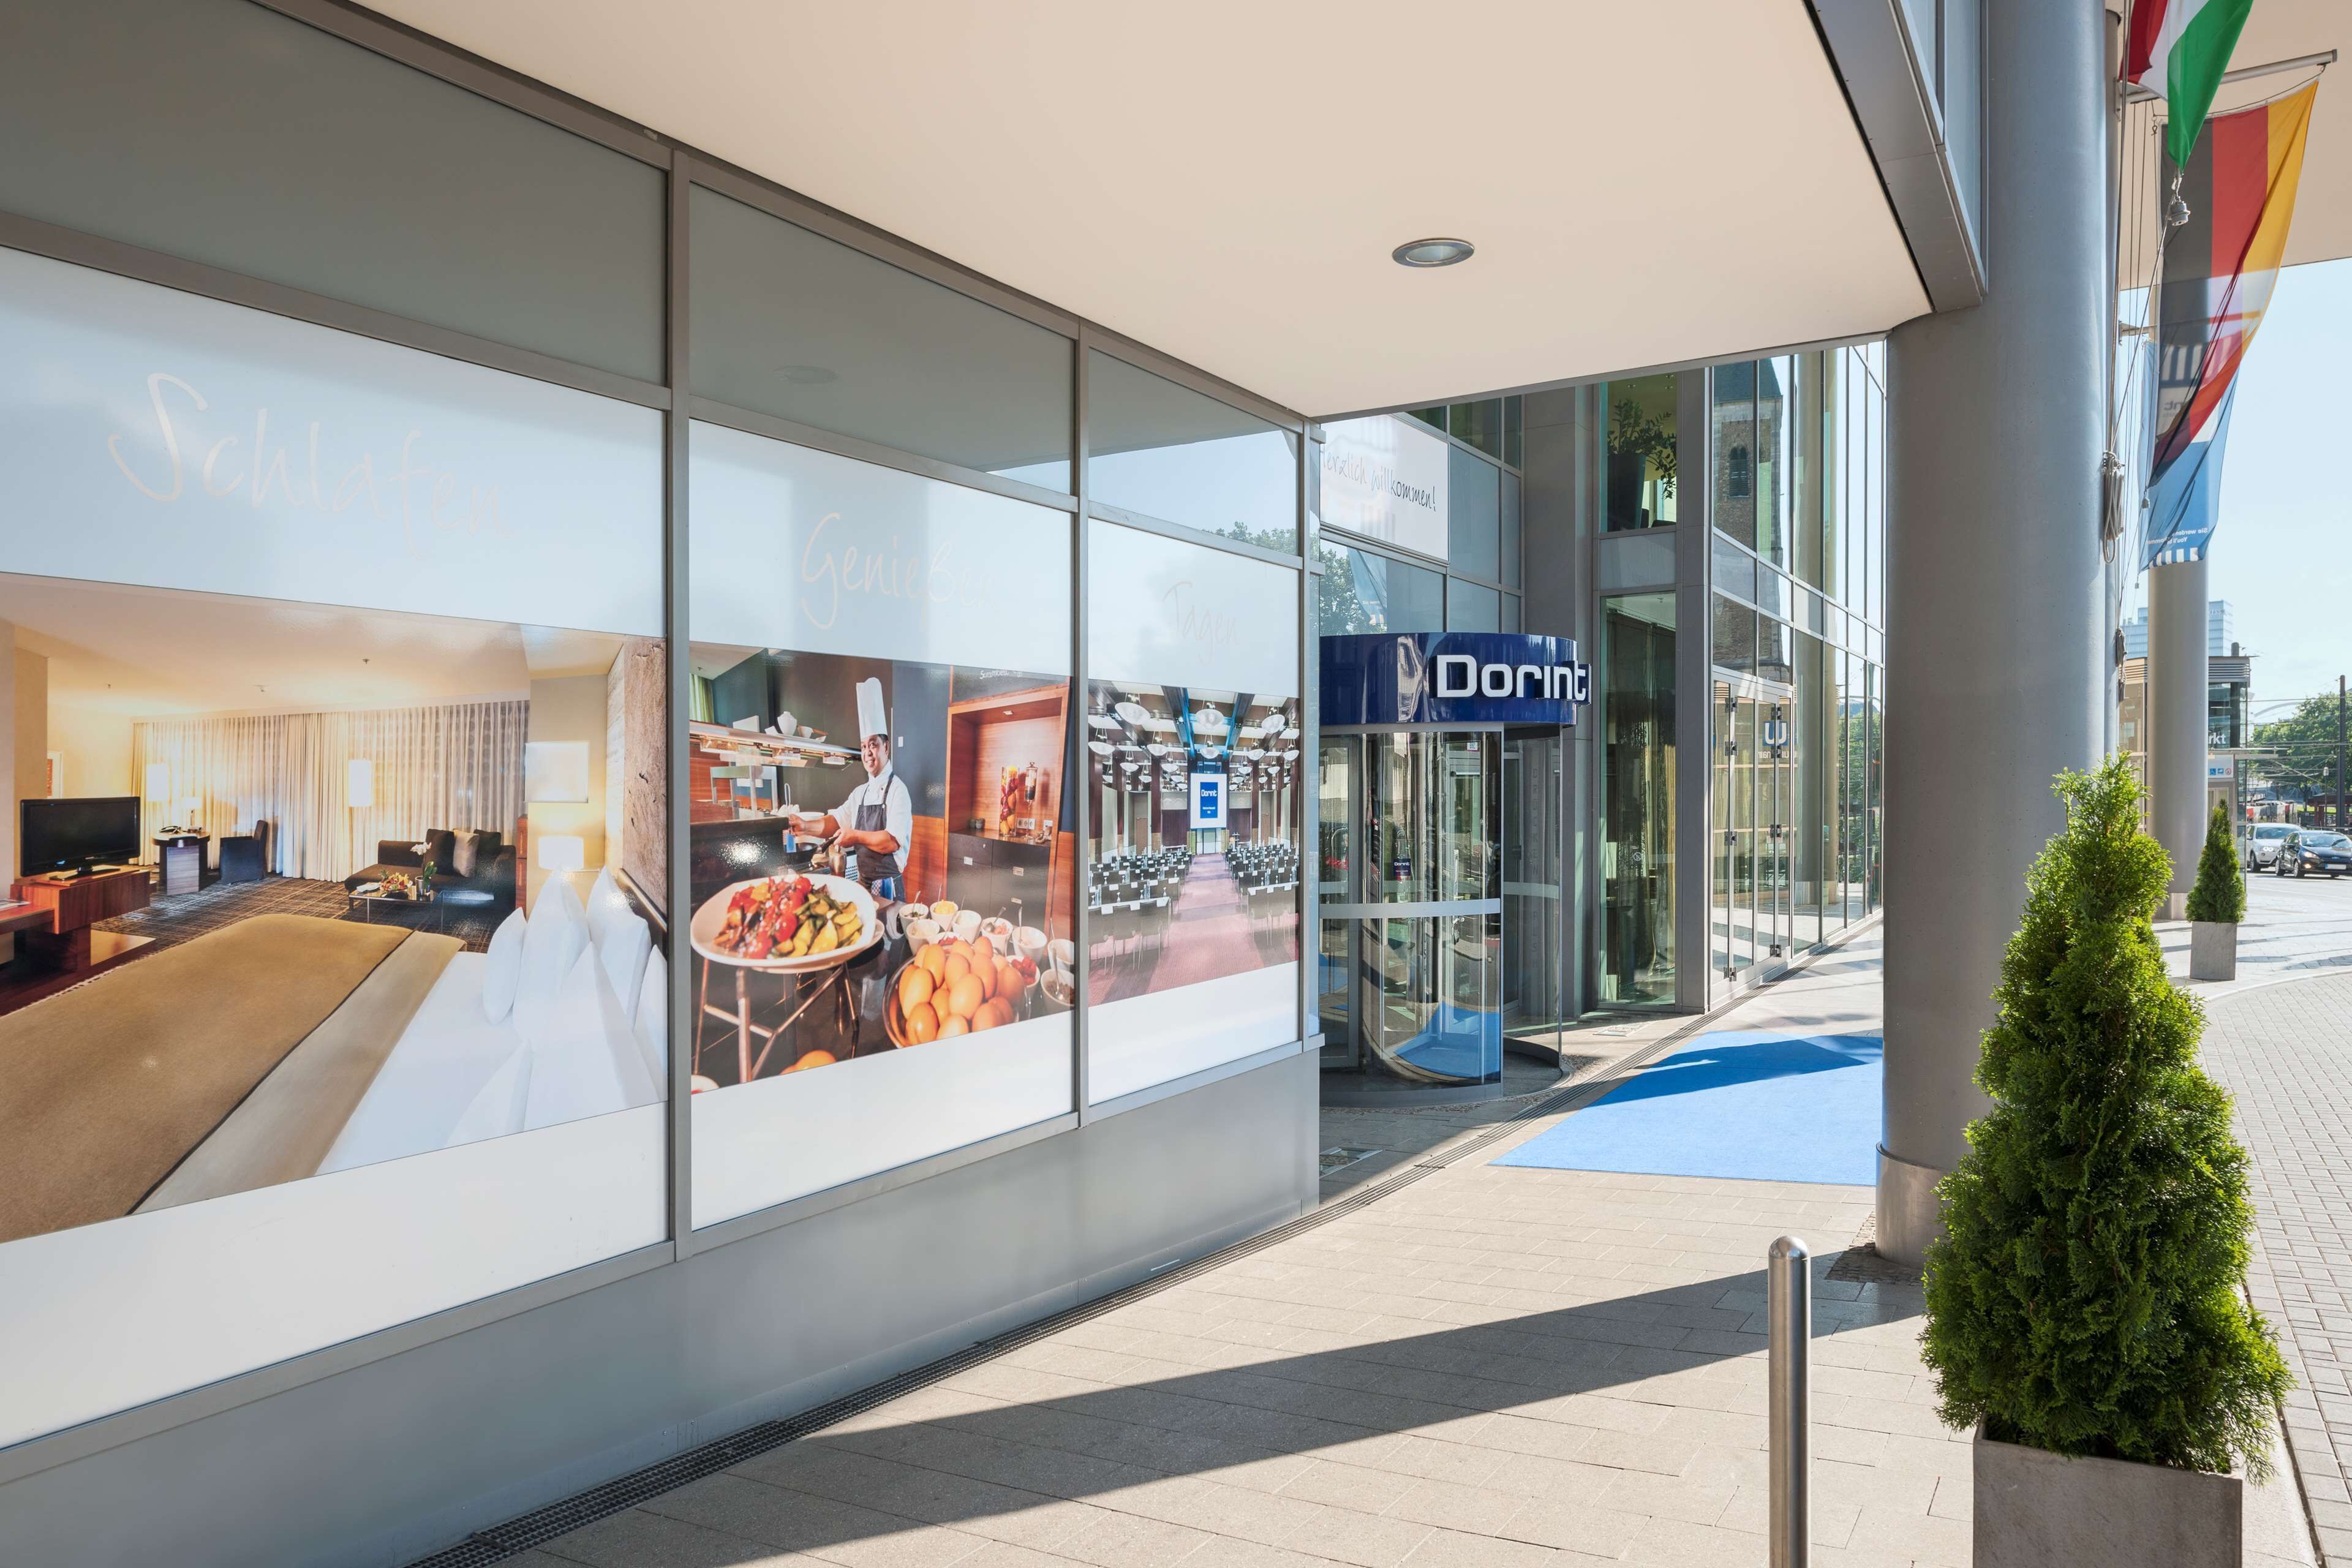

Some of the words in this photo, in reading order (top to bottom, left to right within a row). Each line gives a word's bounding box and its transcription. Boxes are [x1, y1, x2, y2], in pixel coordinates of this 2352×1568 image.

[108, 372, 506, 560] Schlafen
[1371, 464, 1437, 512] willkommen!
[1161, 580, 1240, 667] Tagen
[1436, 654, 1589, 702] Dorint
[2208, 732, 2226, 745] rkt
